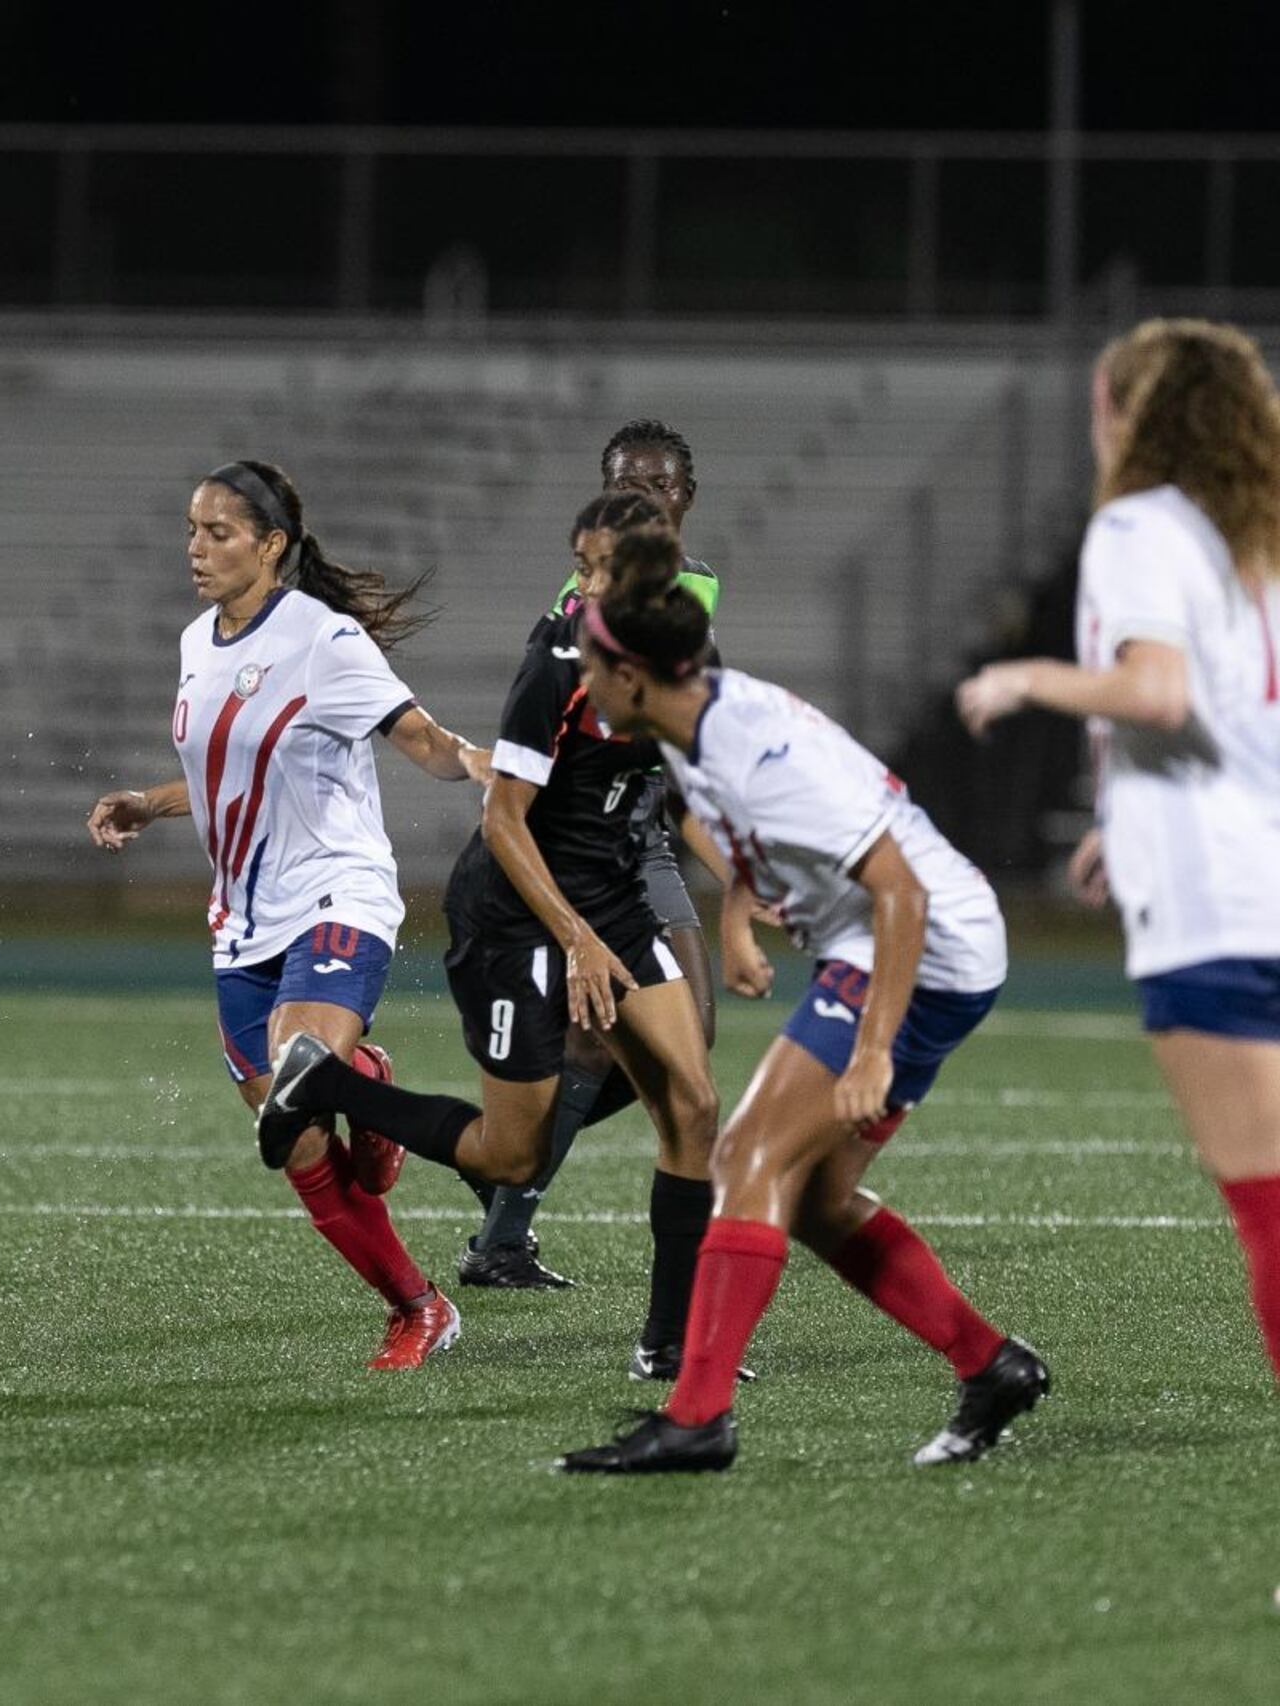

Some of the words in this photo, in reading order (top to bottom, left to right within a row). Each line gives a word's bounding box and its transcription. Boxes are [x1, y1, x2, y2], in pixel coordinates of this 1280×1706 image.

[175, 699, 189, 743] 0
[311, 921, 360, 958] 10
[489, 999, 515, 1060] 9
